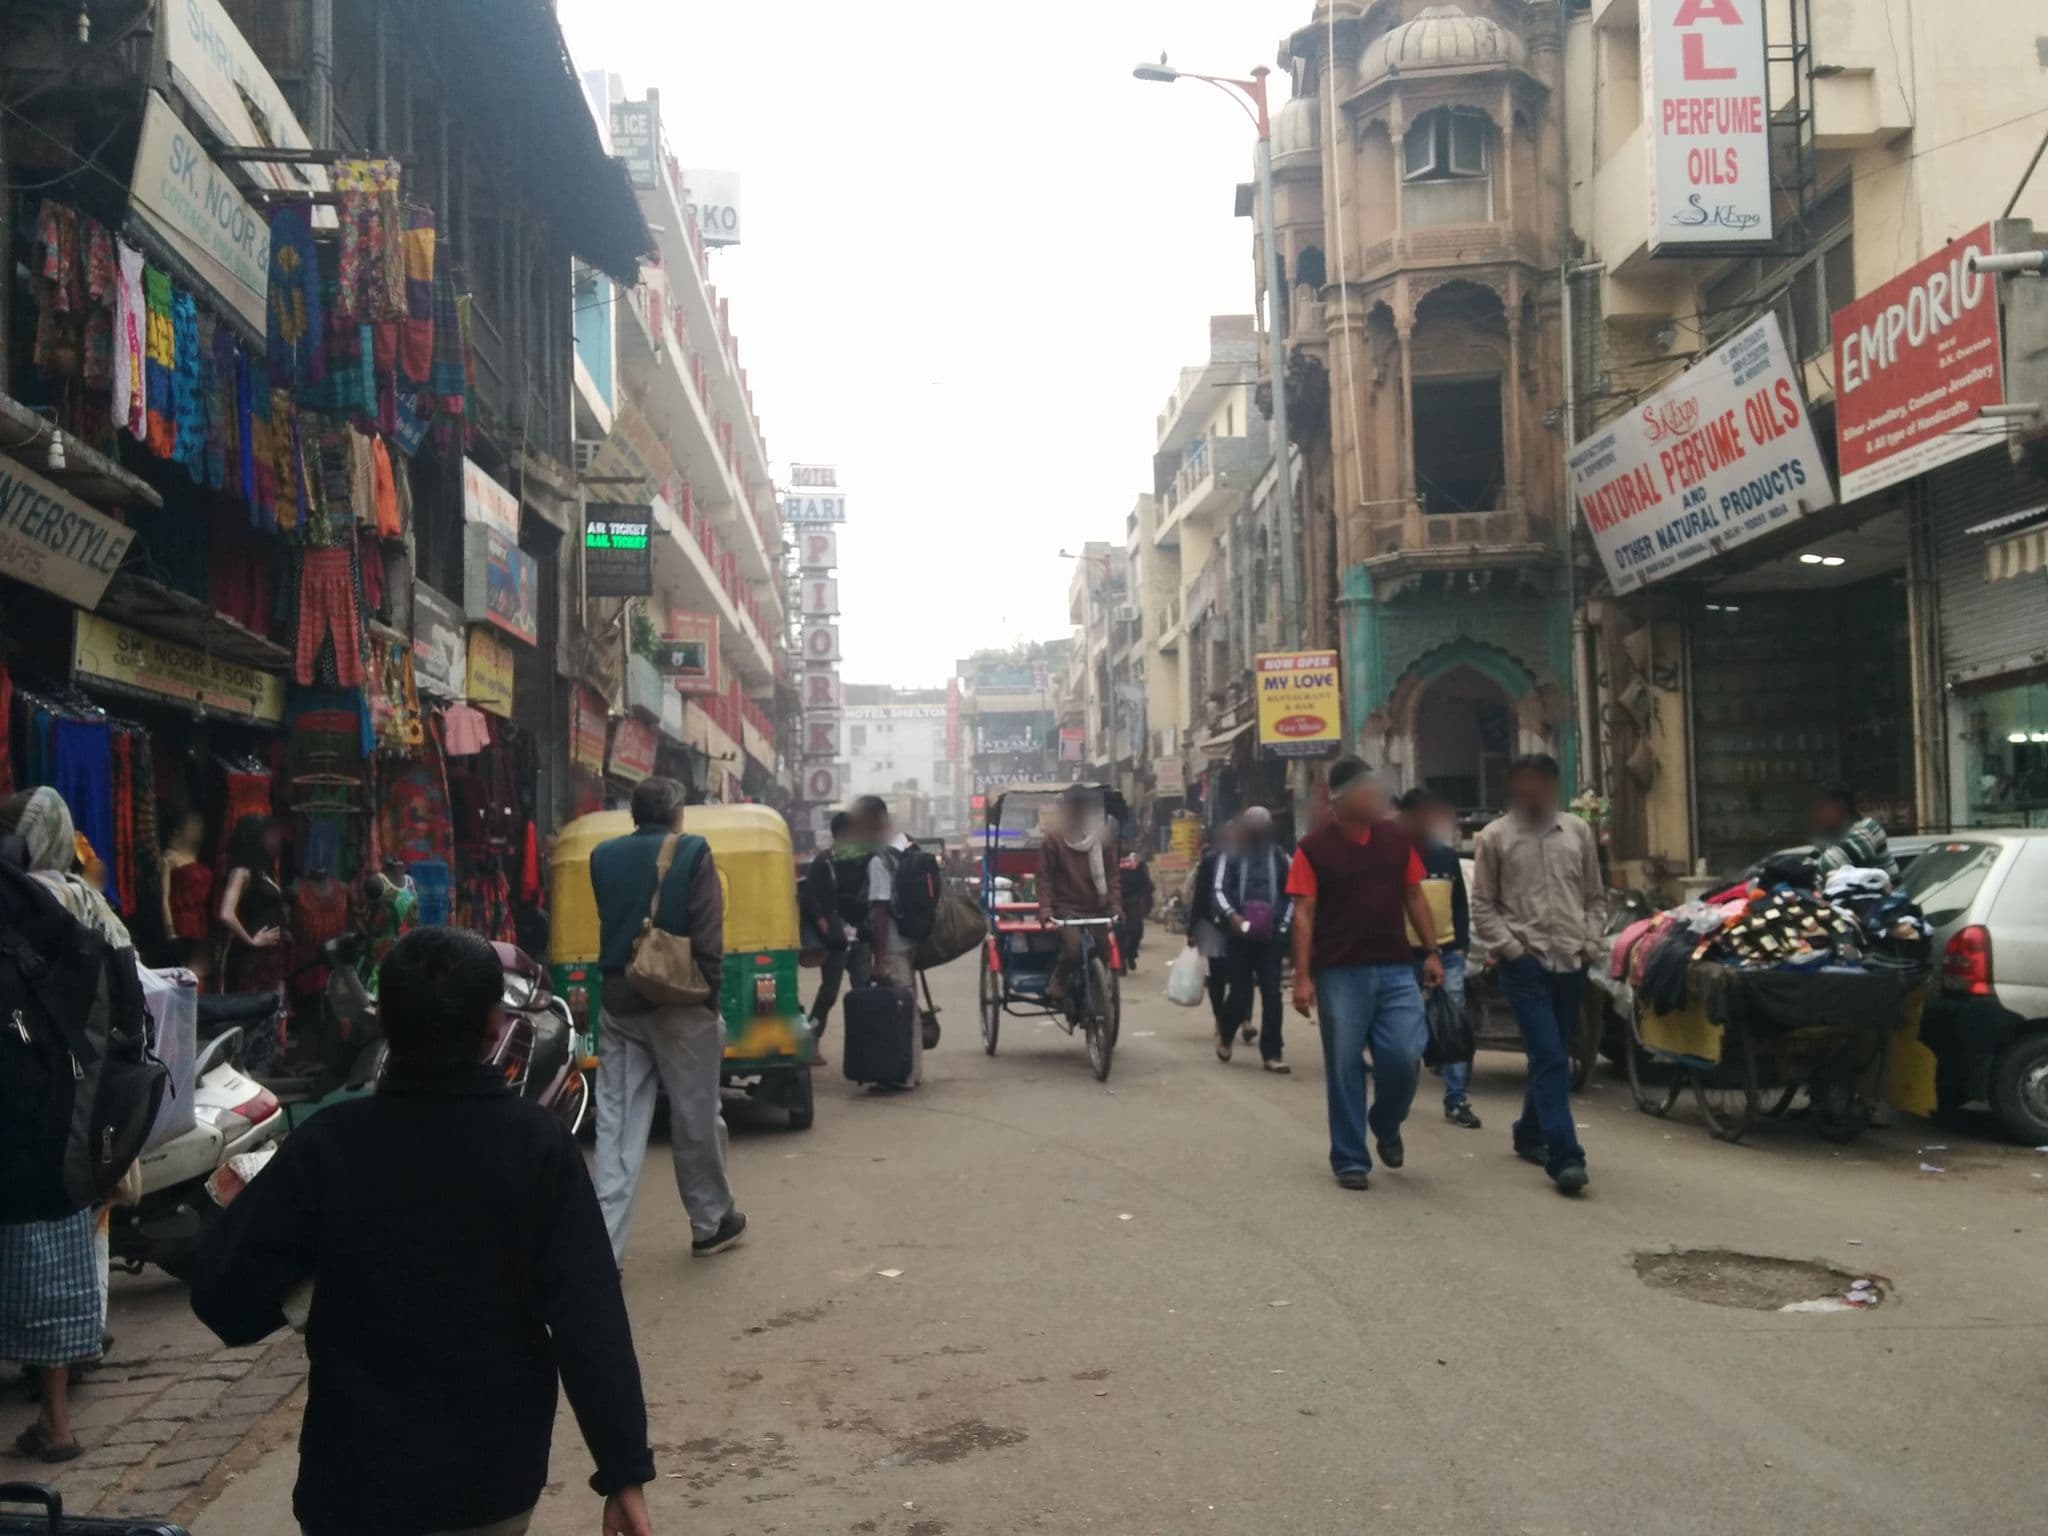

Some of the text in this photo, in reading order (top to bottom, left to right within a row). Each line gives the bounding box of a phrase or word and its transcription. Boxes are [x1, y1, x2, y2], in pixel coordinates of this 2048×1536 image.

[1663, 97, 1763, 136] PERFUME
[1688, 148, 1738, 185] OILS
[205, 175, 256, 258] NOOR
[1843, 245, 1984, 393] EMPORIO
[1583, 377, 1800, 536] NATURAL PERFUME OILS
[786, 498, 845, 519] HARI
[1614, 534, 1656, 570] OTHER
[1655, 503, 1721, 552] NATURAL
[1719, 458, 1806, 521] PRODUCTS
[1682, 487, 1707, 512] AND
[609, 523, 648, 535] TICKET
[223, 666, 265, 693] SONS
[807, 535, 834, 795] PIORKO
[1264, 673, 1335, 691] MY LOVE
[976, 774, 1030, 786] SATYAM
